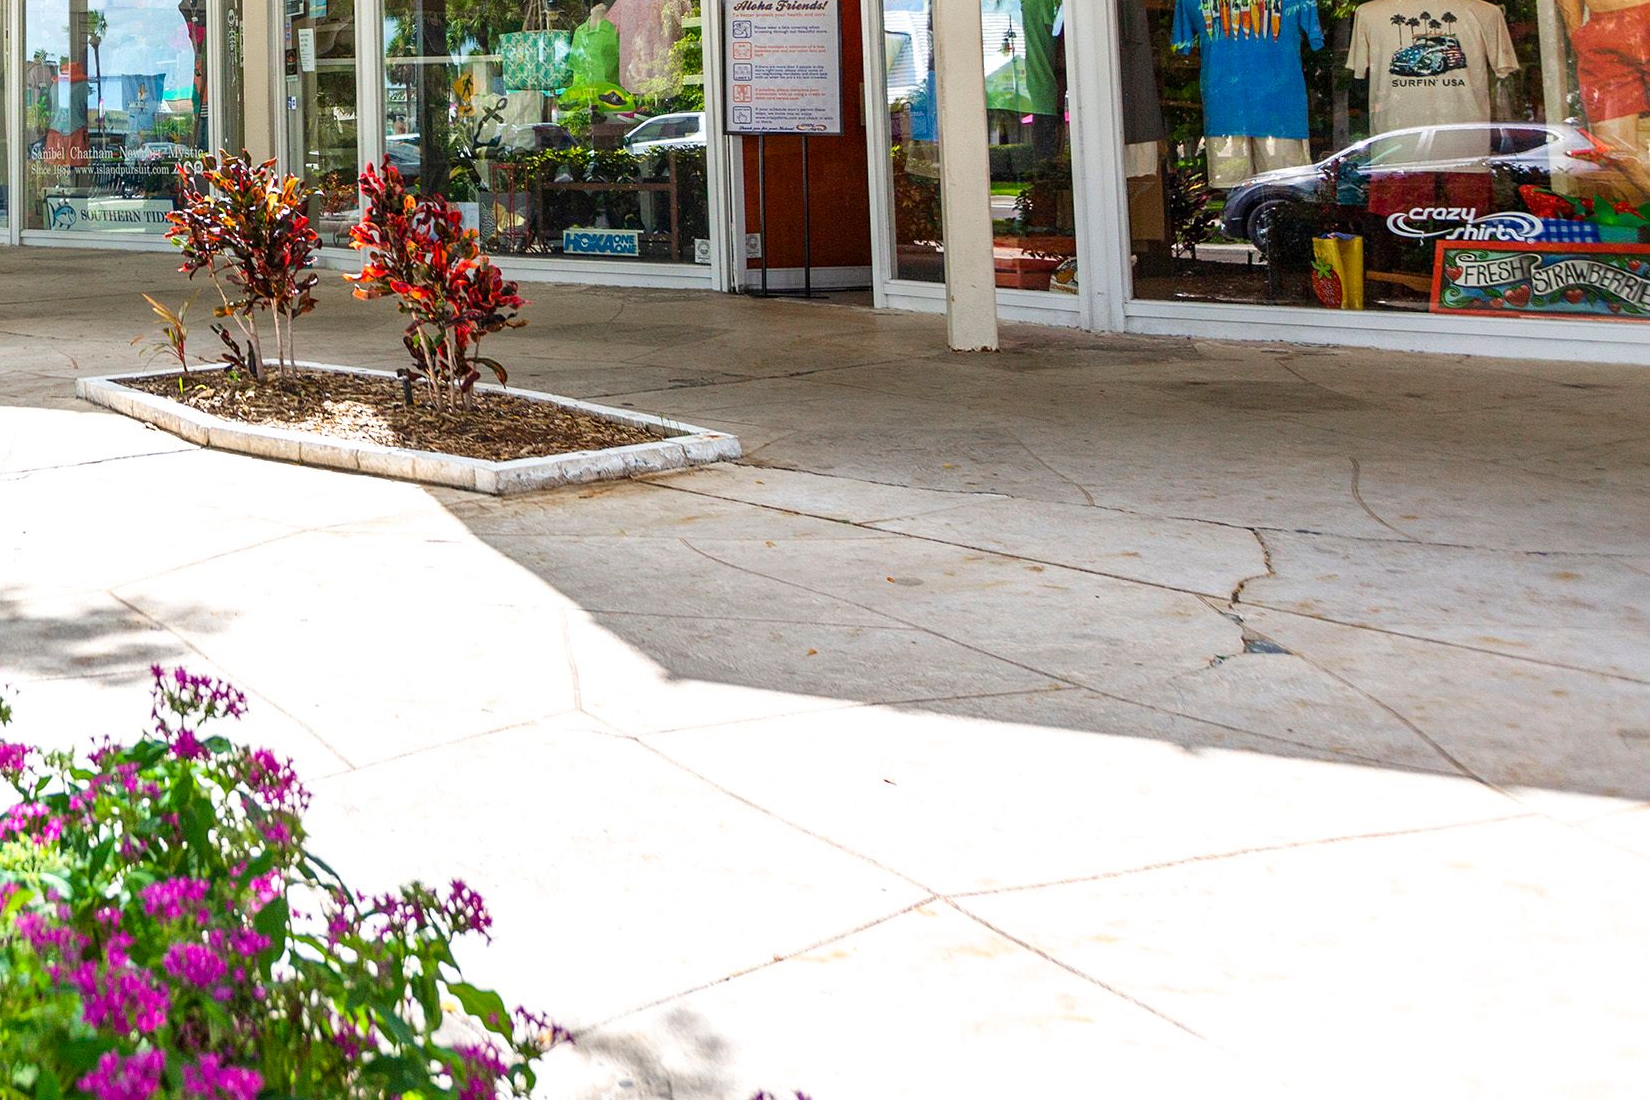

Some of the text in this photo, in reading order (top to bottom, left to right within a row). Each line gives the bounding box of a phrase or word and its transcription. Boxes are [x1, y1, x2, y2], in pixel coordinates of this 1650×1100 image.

[733, 0, 828, 12] Aloha Friends!
[1391, 78, 1466, 87] SURFIN' USA
[31, 146, 65, 160] Sanibel
[70, 146, 113, 160] Chatham
[168, 145, 204, 161] Mystic
[75, 164, 169, 177] www.islandpursuit.com
[80, 209, 141, 223] SOUTHERN
[1408, 207, 1476, 223] crazy
[564, 232, 615, 252] HOKA
[613, 234, 635, 244] ONE
[615, 244, 636, 254] ONE
[1464, 259, 1525, 285] FRESH
